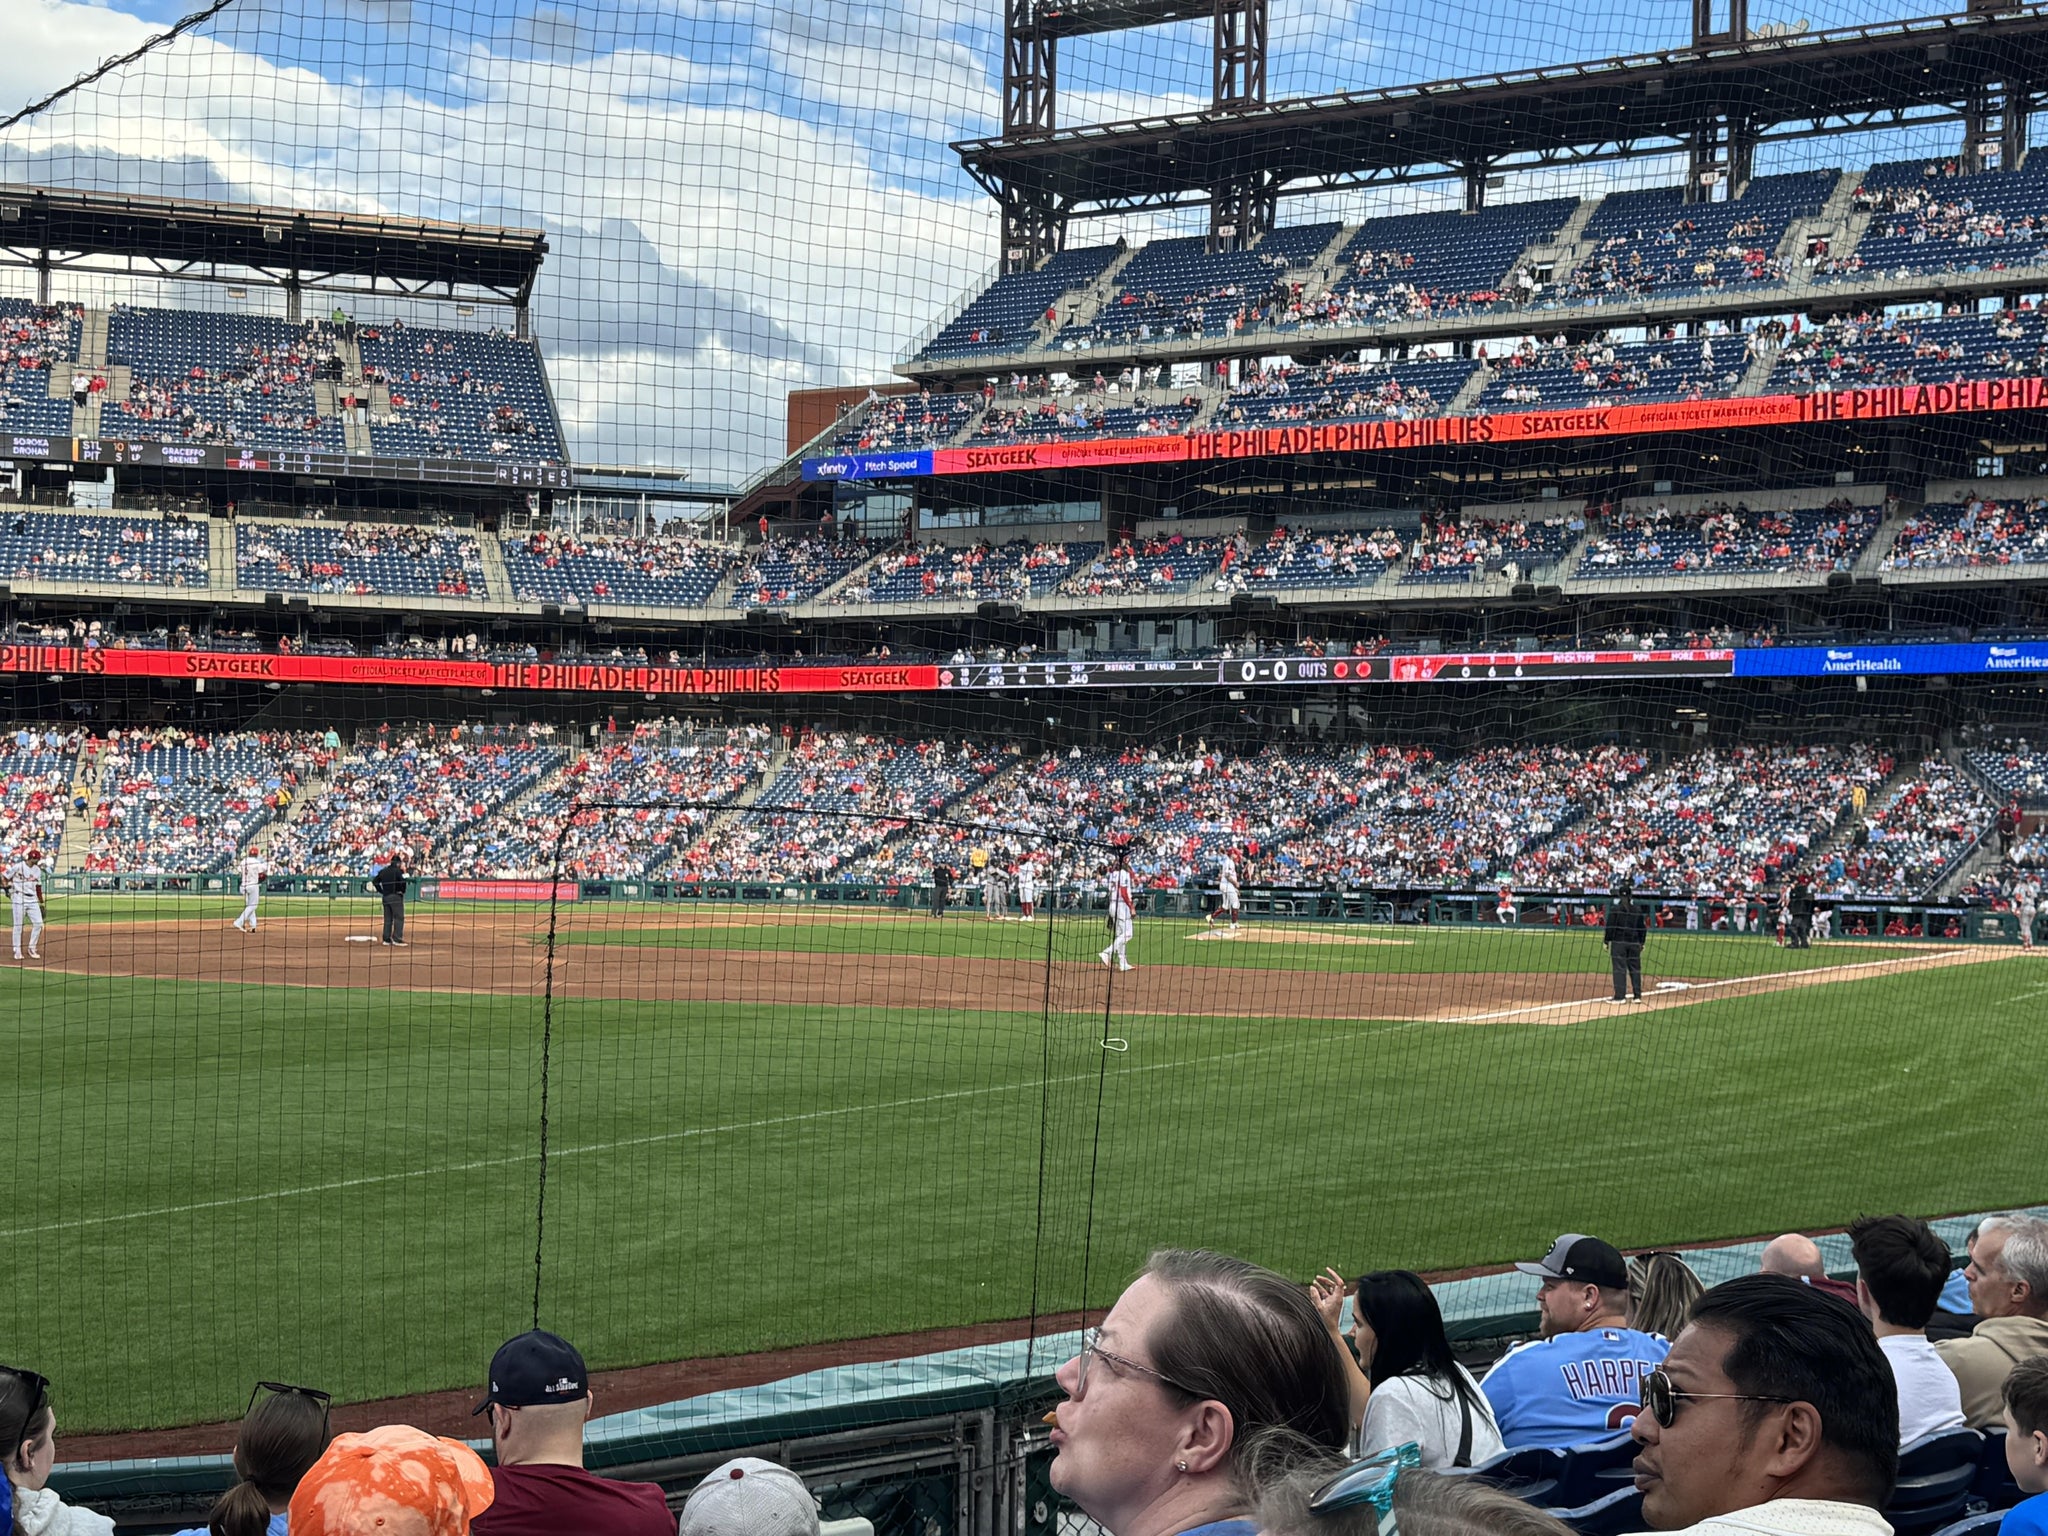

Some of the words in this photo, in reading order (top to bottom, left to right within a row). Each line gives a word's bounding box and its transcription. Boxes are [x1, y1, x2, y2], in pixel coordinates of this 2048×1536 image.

[1640, 412, 1678, 423] OFFICIAL
[1681, 409, 1711, 420] TICKET
[1713, 405, 1777, 419] MARKETPLACE
[1779, 404, 1791, 414] OF
[1795, 393, 1844, 421] THE
[1522, 411, 1611, 435] SEATGEEK
[1184, 432, 1225, 459] THE
[1230, 424, 1387, 458] PHILADELPHIA
[1395, 416, 1493, 448] PHILLIES
[13, 446, 49, 456] DROHAN
[82, 441, 102, 450] STL
[113, 443, 124, 452] 10
[161, 447, 206, 457] GRACEFFO
[1062, 447, 1092, 459] OFFICIAL
[1094, 445, 1118, 457] TICKET
[1119, 443, 1171, 456] MARKETPLACE
[84, 451, 100, 461] PIT
[168, 455, 199, 464] SKENES
[966, 448, 1038, 468] SEATGEEK
[239, 460, 256, 469] PHI
[817, 462, 848, 476] xfinity
[865, 460, 887, 472] Pitch
[888, 460, 917, 473] Speed
[499, 469, 507, 479] R
[523, 470, 532, 480] H
[548, 472, 555, 482] E
[0, 646, 105, 673] PHILLIES
[186, 656, 274, 676] SEATGEEK
[1192, 662, 1203, 670] LA
[1822, 658, 1901, 672] AmeriHealth
[352, 664, 388, 677] OFFICIAL
[390, 666, 416, 677] TICKET
[419, 667, 474, 679] MARKETPLACE
[1104, 663, 1135, 671] DISTANCE
[1299, 662, 1327, 678] OUTS
[1461, 666, 1471, 678] 0
[490, 663, 532, 688] THE
[538, 665, 695, 692] PHILADELPHIA
[702, 668, 780, 692] PHILLIES
[841, 670, 909, 687] SEATGEEK
[986, 675, 1005, 686] .292
[1067, 674, 1088, 685] .340
